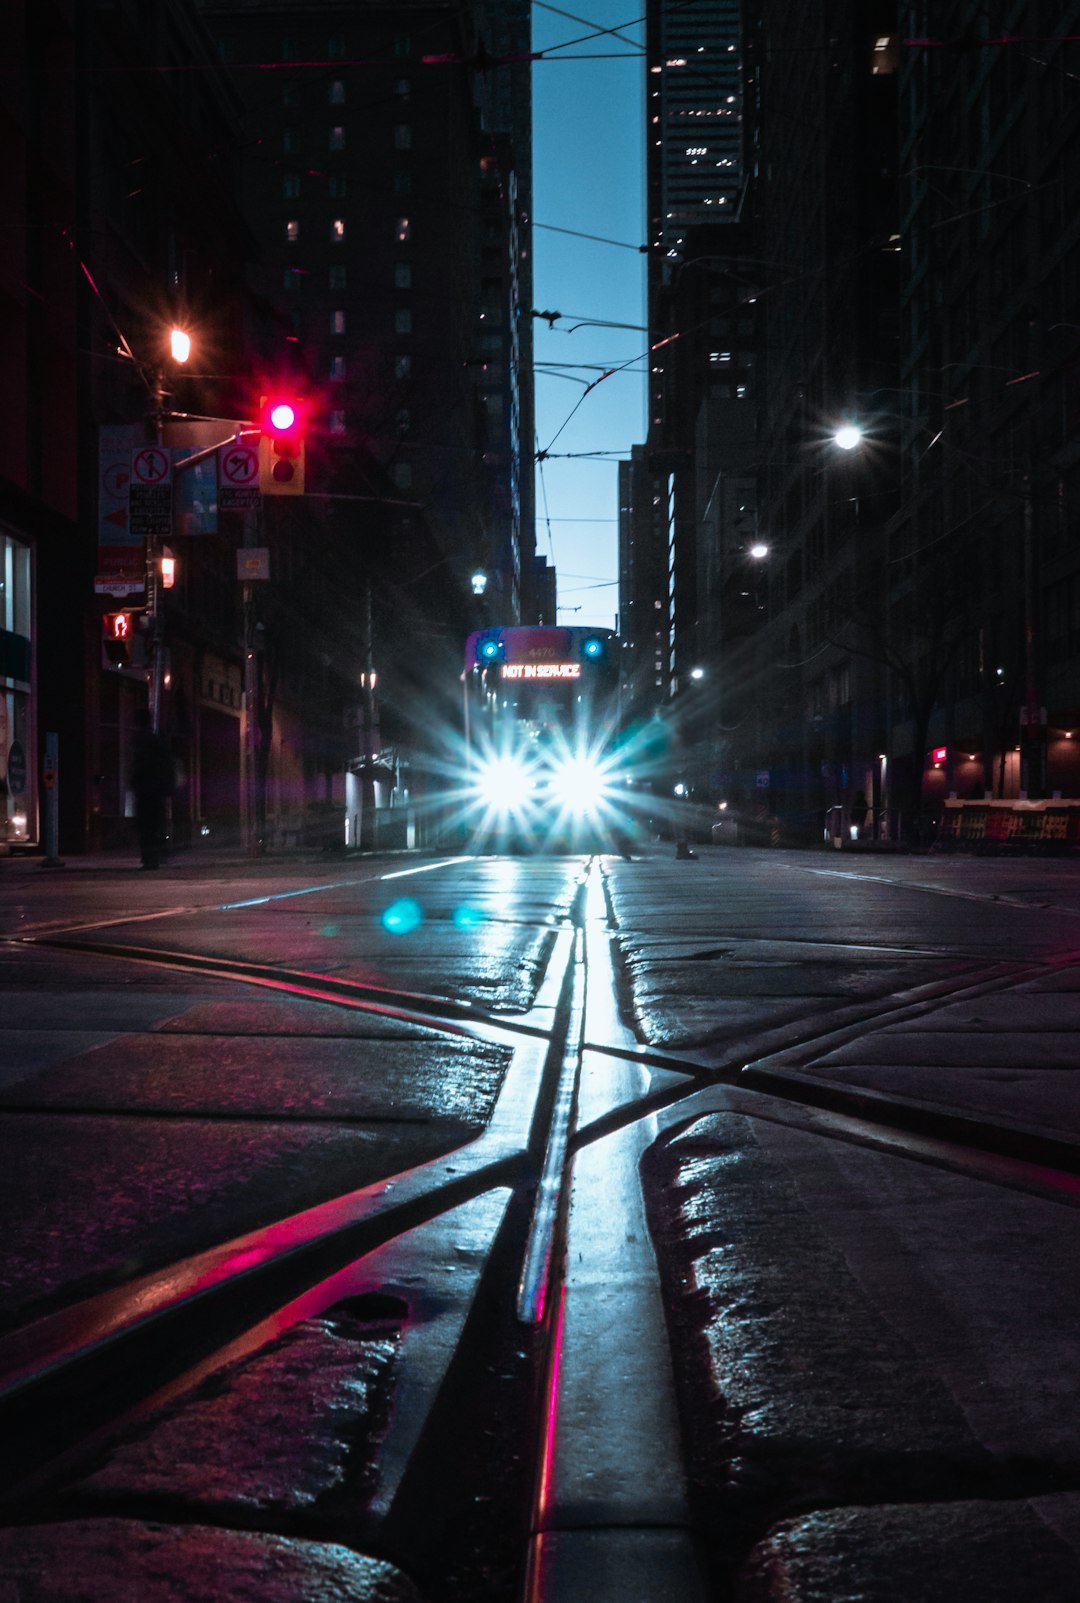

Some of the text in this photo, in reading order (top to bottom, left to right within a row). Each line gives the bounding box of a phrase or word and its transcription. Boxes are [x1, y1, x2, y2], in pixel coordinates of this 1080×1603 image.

[528, 647, 556, 658] 4470
[502, 663, 580, 677] NOT IN SERVICE
